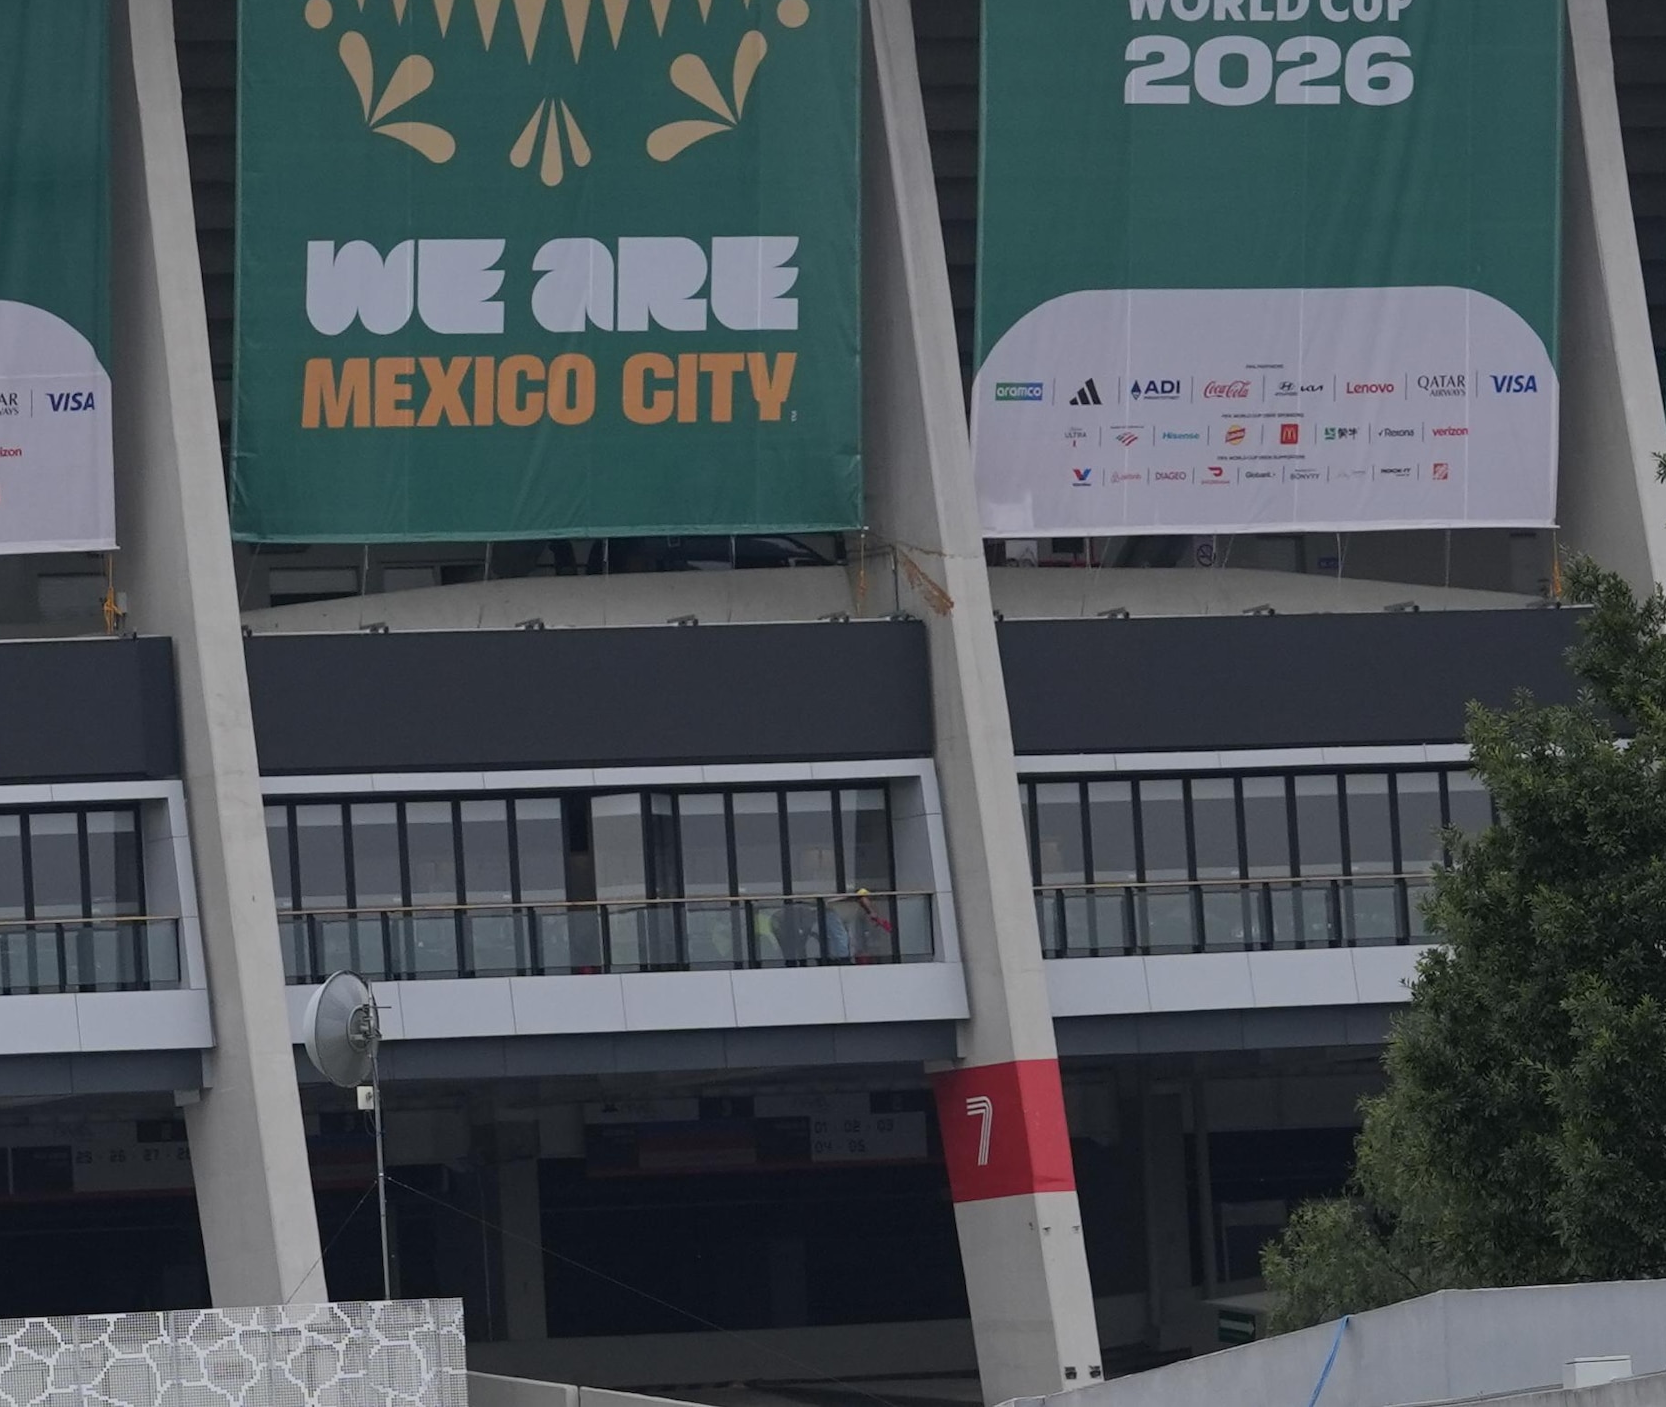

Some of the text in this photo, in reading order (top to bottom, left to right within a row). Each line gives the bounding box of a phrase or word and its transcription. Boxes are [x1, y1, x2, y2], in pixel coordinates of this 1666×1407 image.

[1124, 35, 1414, 106] 2026
[306, 238, 506, 336] WE
[301, 352, 797, 428] MEXICO CITY
[1144, 380, 1181, 394] ADI
[1346, 382, 1395, 394] Lenovo
[1417, 374, 1465, 390] QATAR
[1489, 374, 1537, 393] VISA
[996, 387, 1042, 397] aramco
[46, 392, 95, 412] VISA
[1432, 426, 1469, 437] verizon
[966, 1096, 993, 1166] 7
